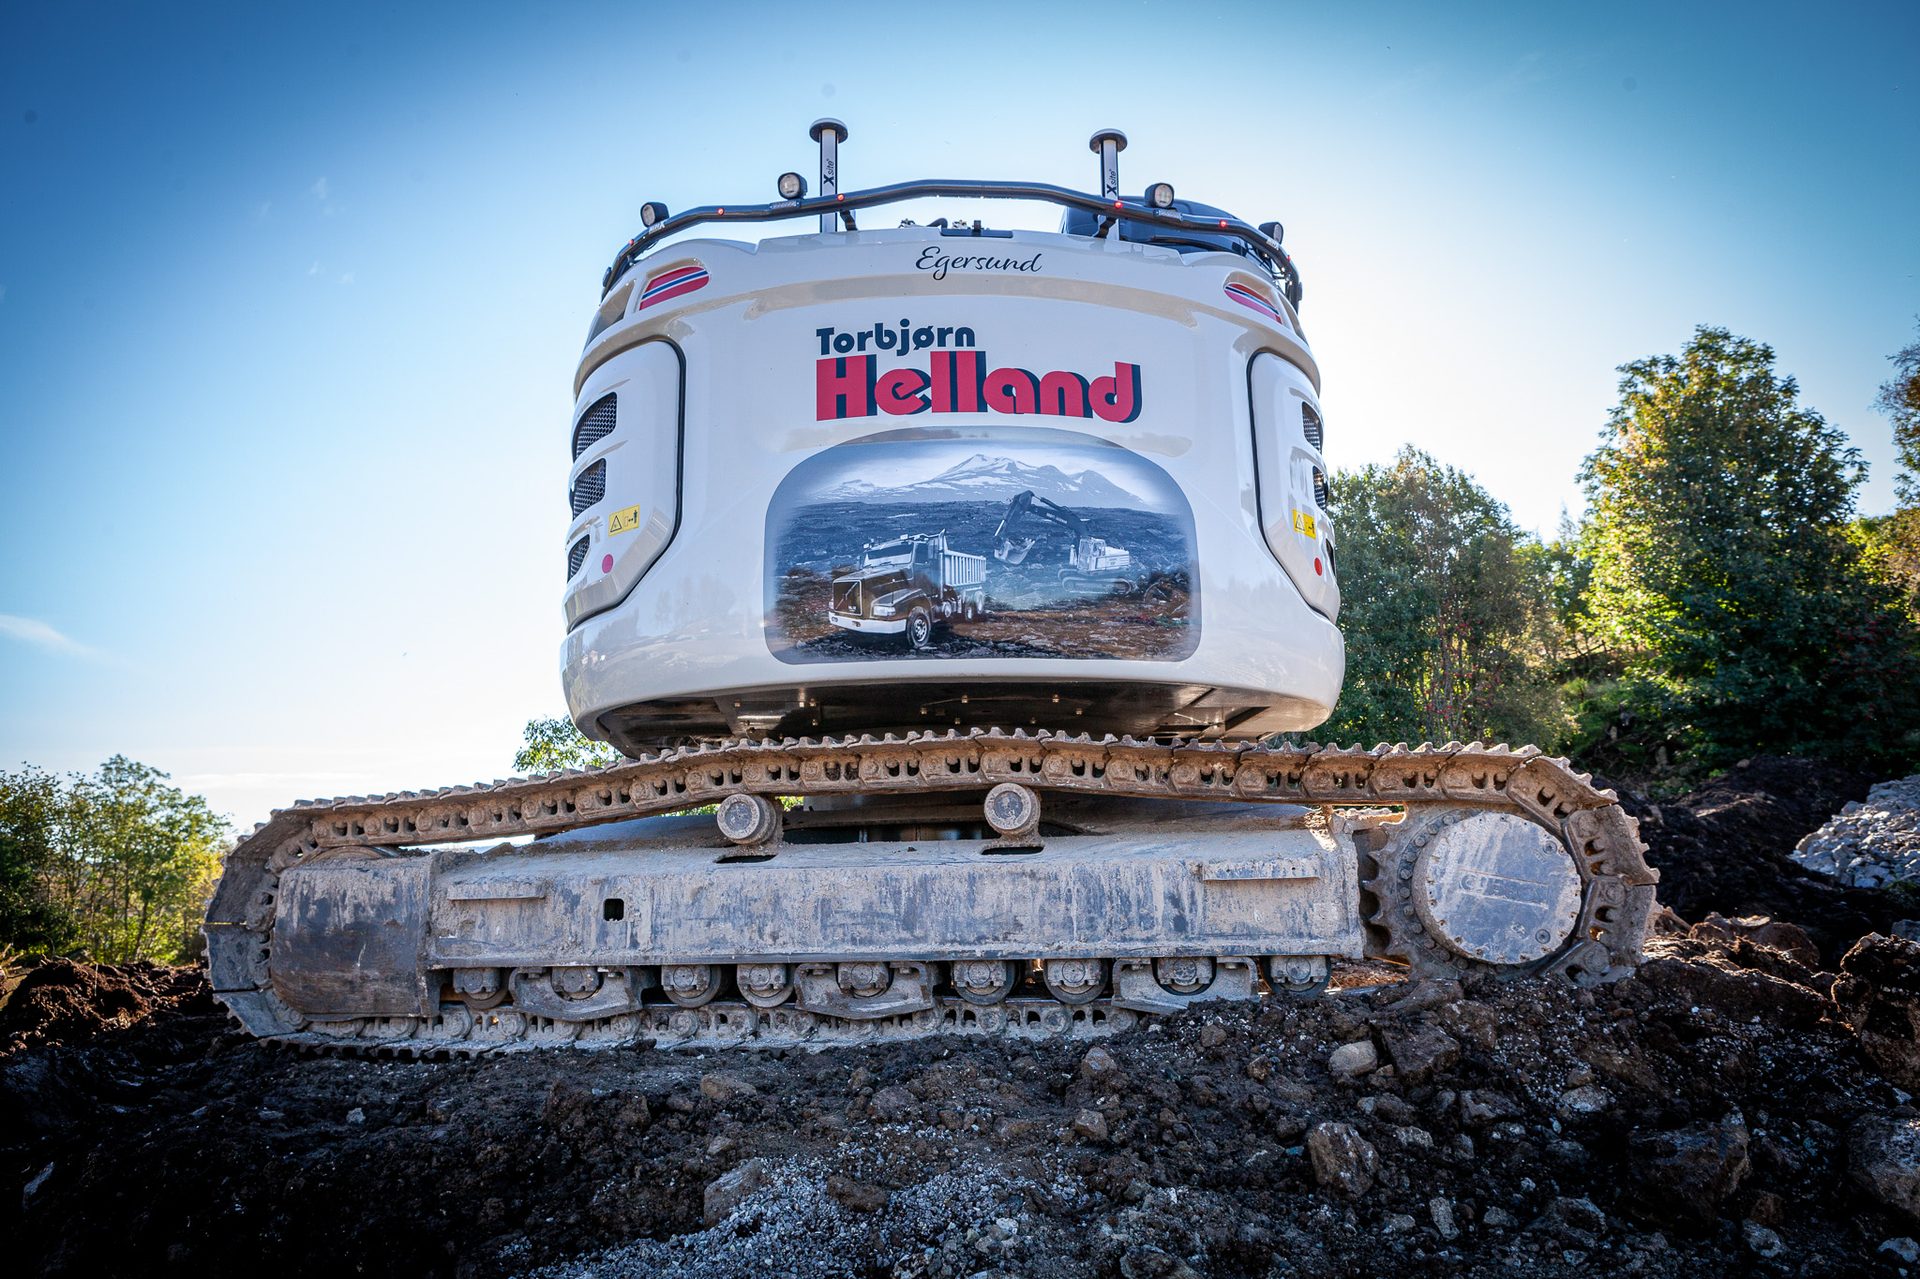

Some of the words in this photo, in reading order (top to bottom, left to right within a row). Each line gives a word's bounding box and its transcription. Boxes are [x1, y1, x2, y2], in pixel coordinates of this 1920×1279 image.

[915, 246, 1043, 281] Egersund
[816, 318, 976, 357] Torbjørn
[816, 350, 1144, 424] Helland
